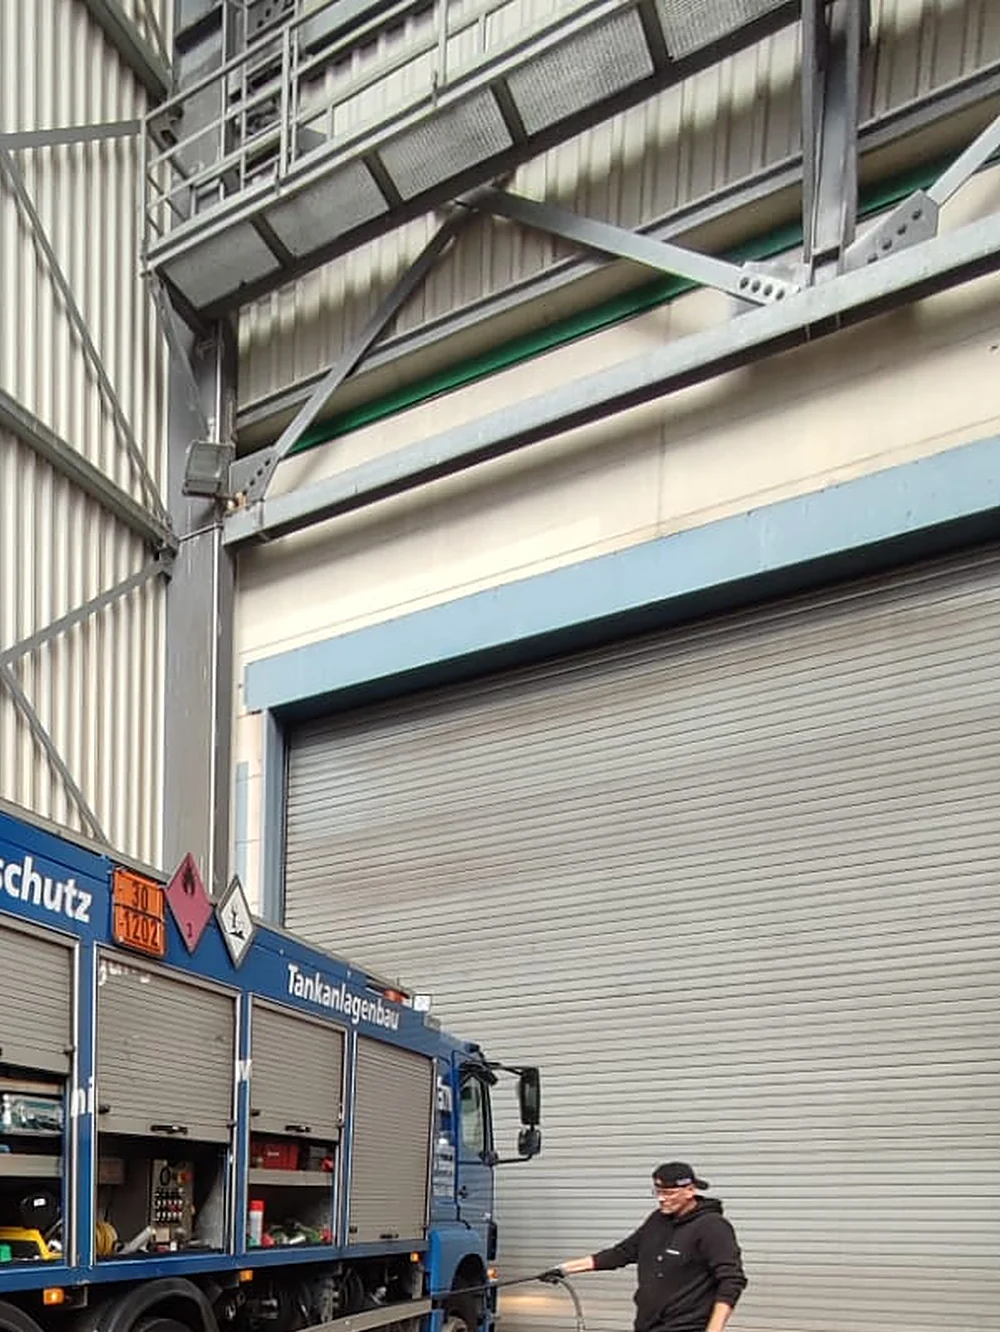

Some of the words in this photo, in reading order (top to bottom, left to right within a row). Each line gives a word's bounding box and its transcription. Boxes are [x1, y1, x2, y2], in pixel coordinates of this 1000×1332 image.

[131, 882, 150, 909] 30
[124, 912, 159, 947] 1202
[287, 963, 401, 1032] Tankanlagenbau
